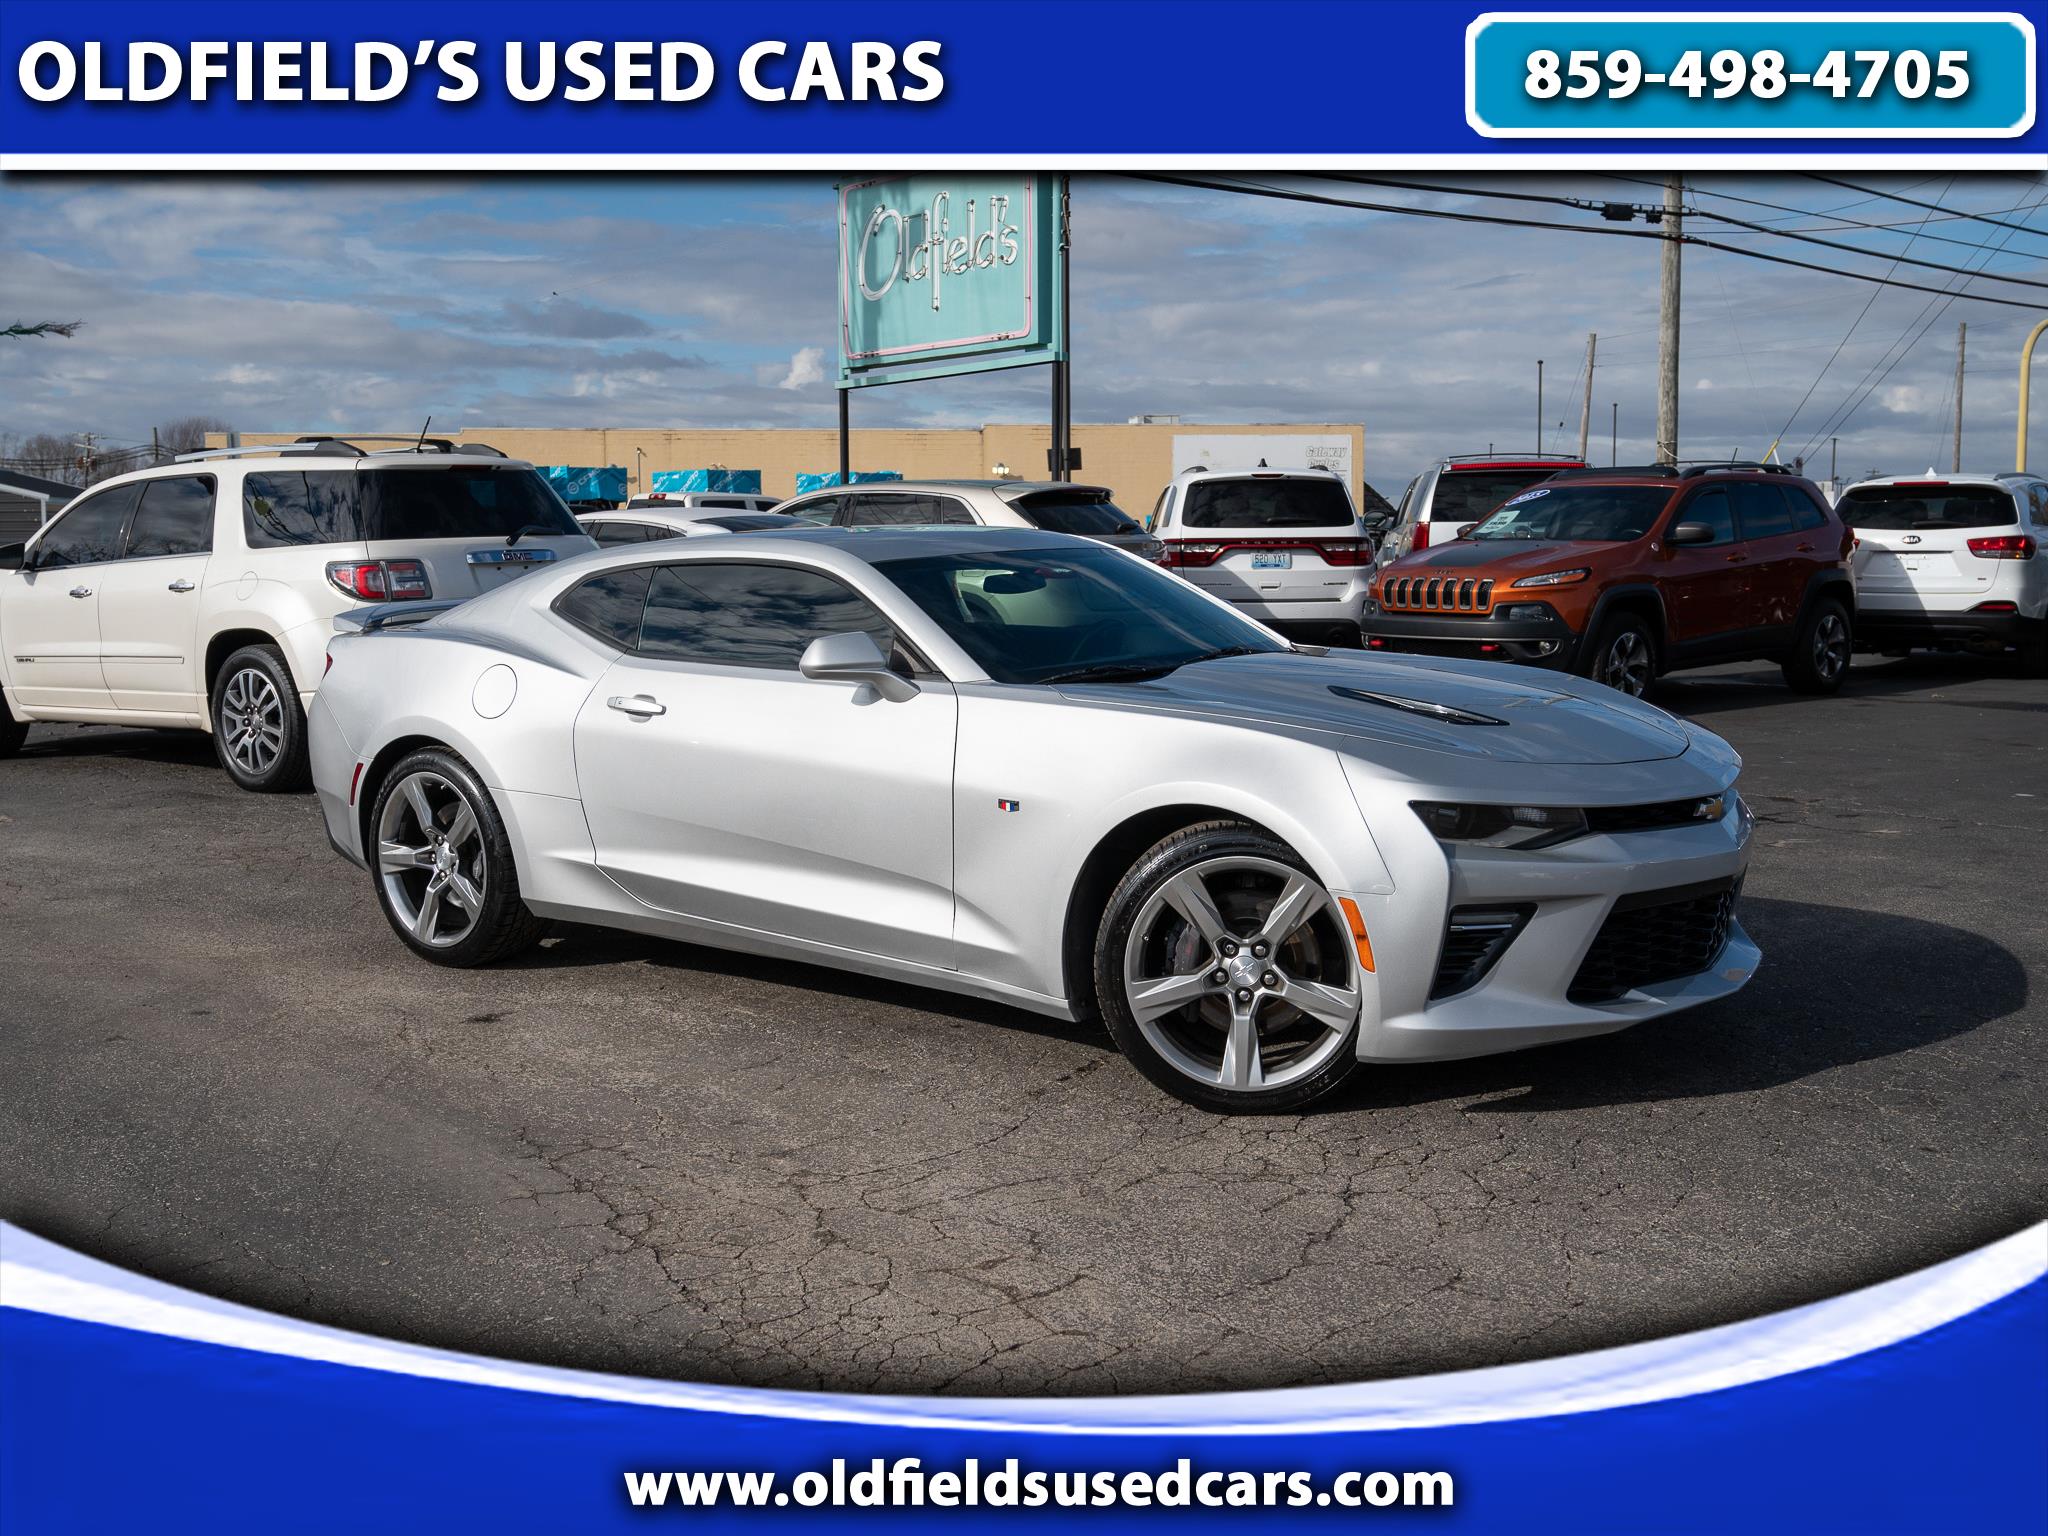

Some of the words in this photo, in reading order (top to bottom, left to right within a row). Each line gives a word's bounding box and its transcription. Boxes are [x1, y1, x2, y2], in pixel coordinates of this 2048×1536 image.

[858, 190, 1018, 312] Oldfield's
[1305, 446, 1347, 458] Gateway
[1903, 535, 1920, 544] KIA
